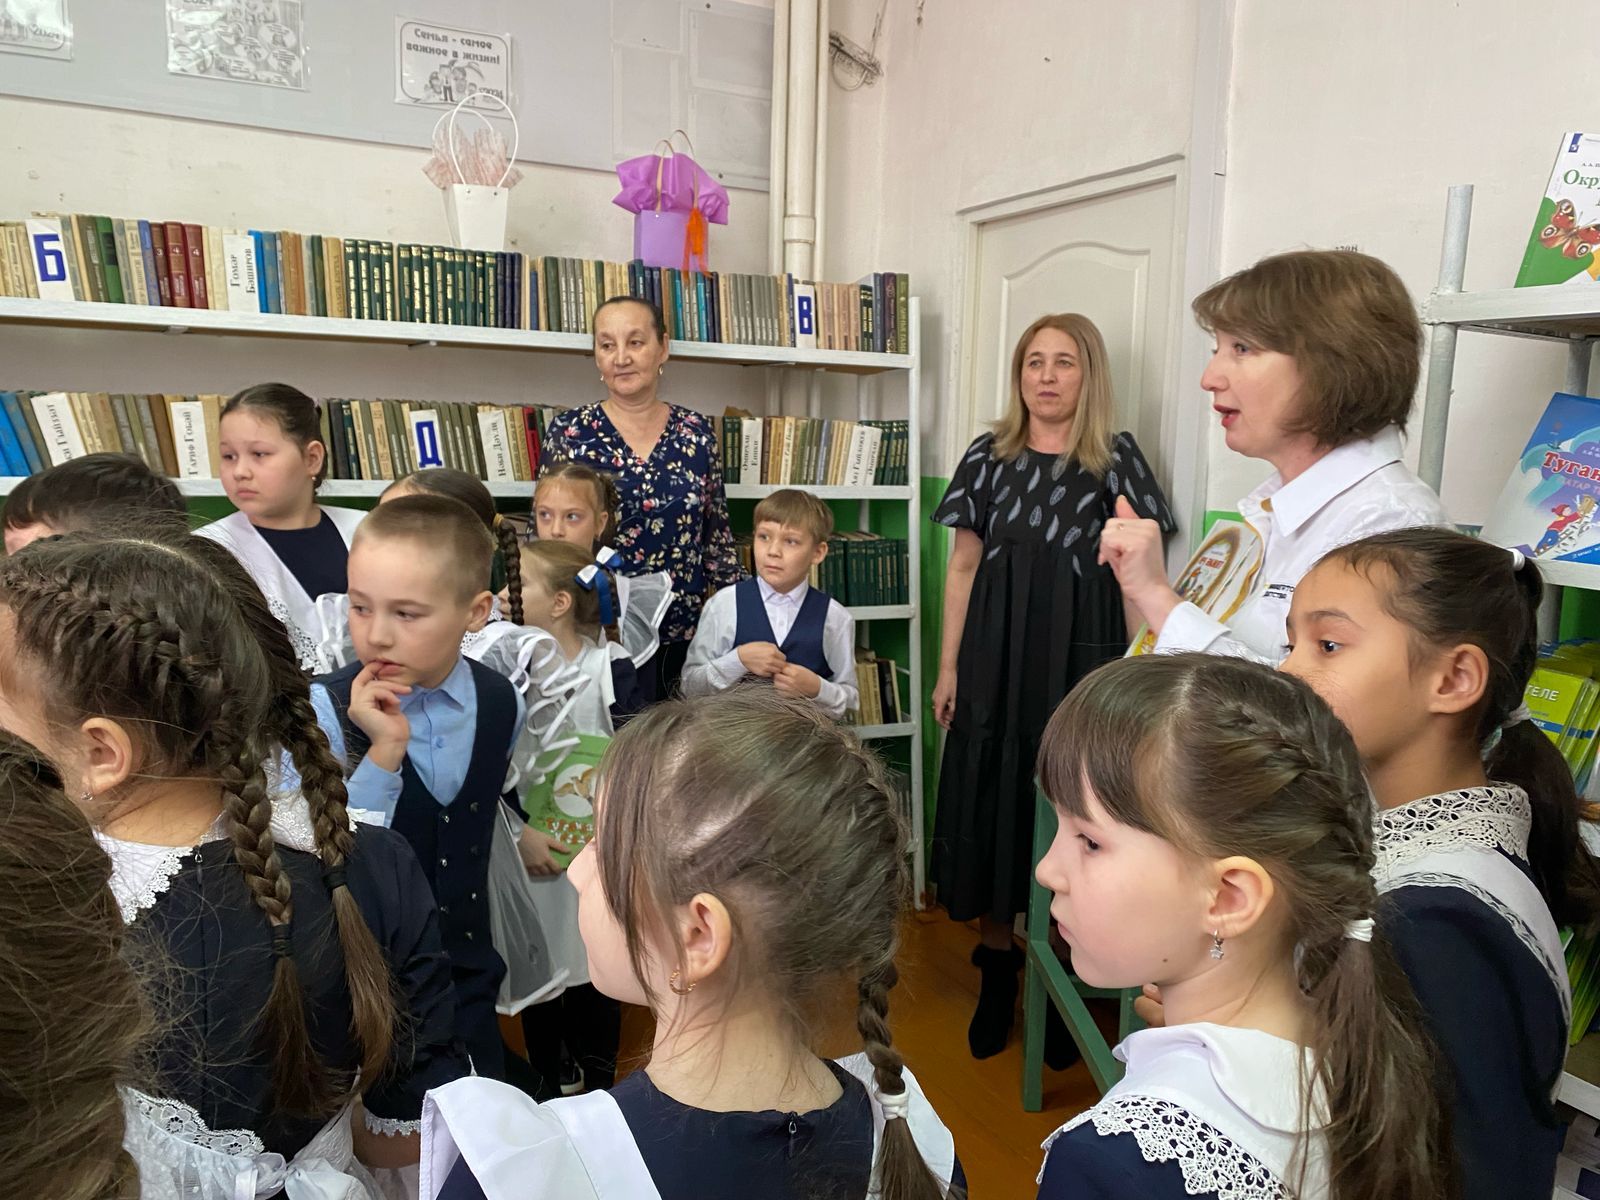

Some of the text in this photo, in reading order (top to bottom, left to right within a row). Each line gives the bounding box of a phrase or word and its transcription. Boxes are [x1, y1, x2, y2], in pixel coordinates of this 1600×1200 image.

[406, 42, 500, 65] важное в жизни!
[414, 28, 449, 42] Семья
[460, 37, 492, 50] самое
[1563, 169, 1600, 190] Окр
[33, 233, 66, 281] Б
[797, 295, 813, 335] В
[416, 420, 442, 468] Д
